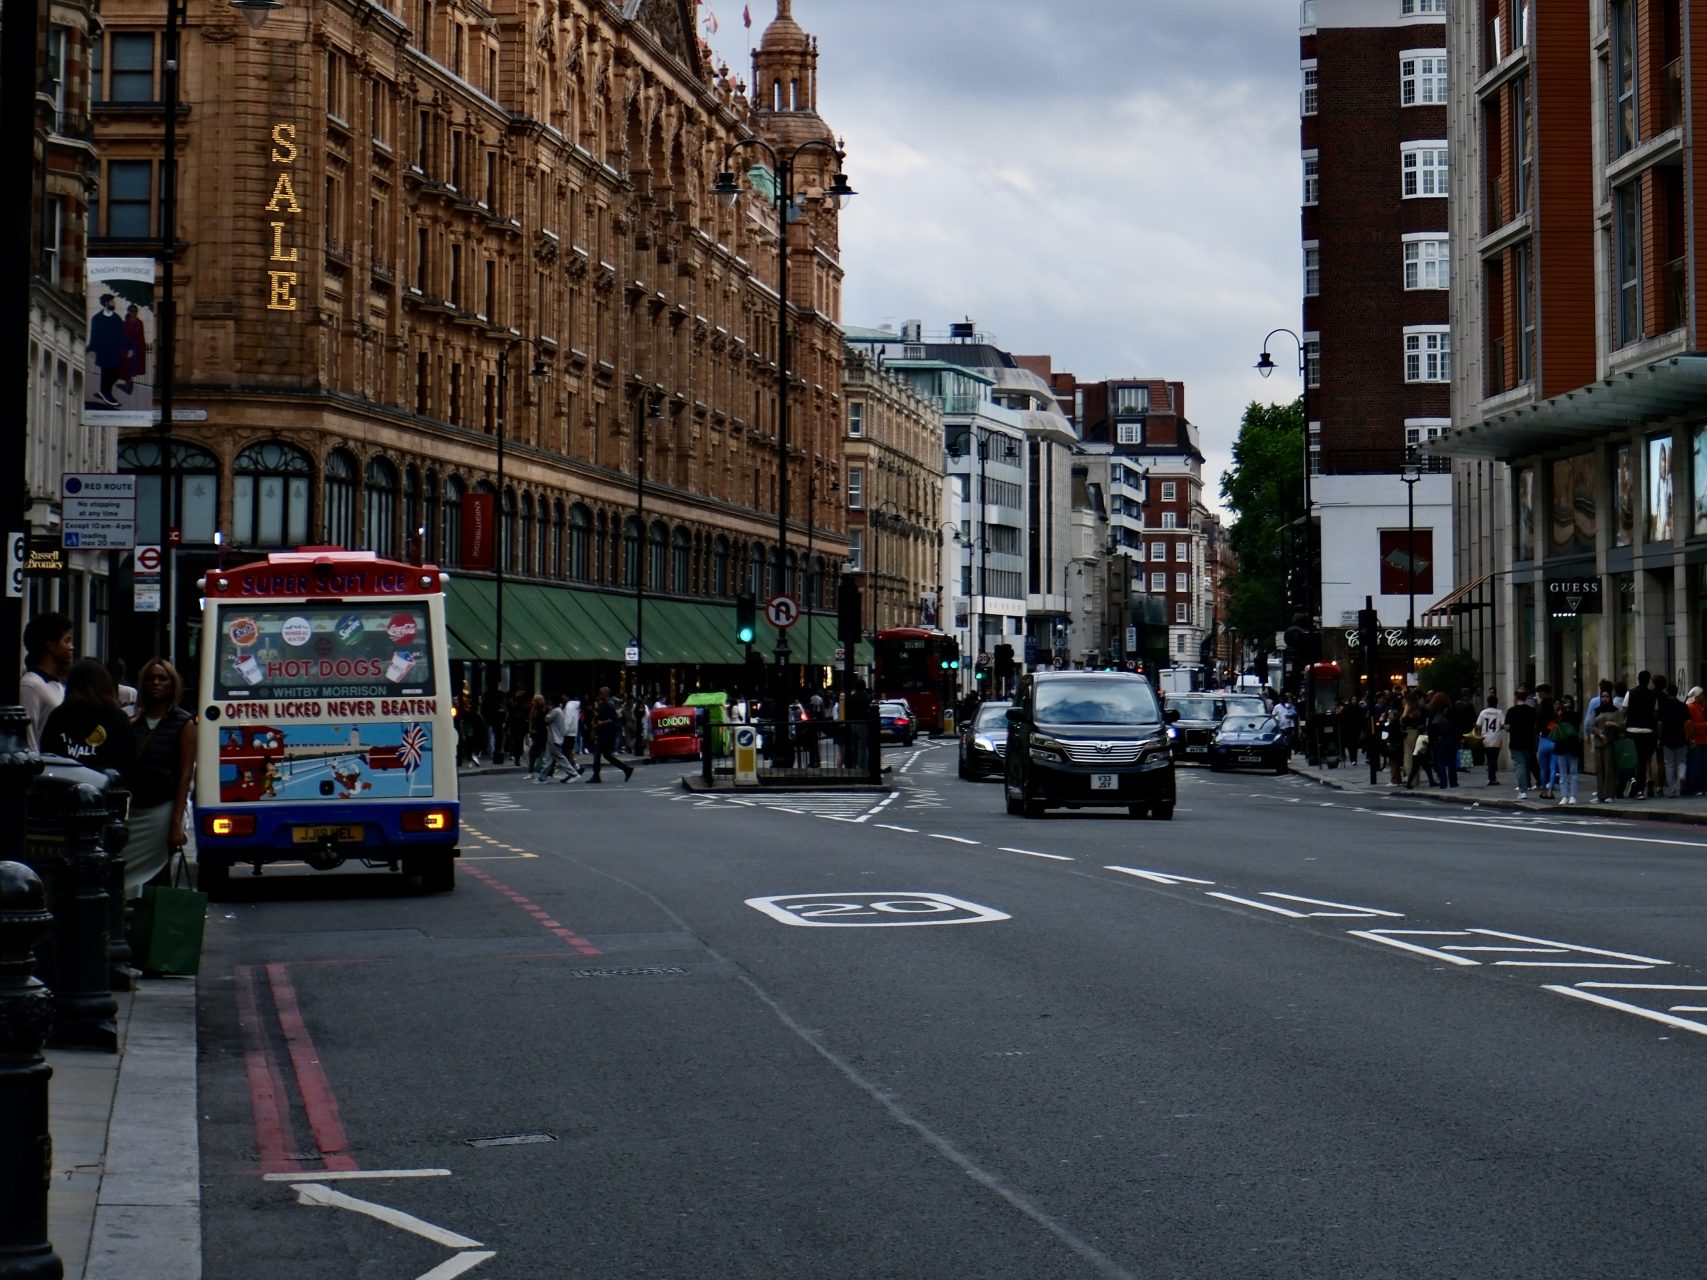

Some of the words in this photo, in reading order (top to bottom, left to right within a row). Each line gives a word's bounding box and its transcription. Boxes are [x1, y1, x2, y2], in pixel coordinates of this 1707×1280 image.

[265, 122, 302, 312] SALE
[241, 575, 307, 595] SUPER
[315, 572, 368, 593] SOFT
[373, 571, 407, 593] ICE
[1550, 582, 1598, 593] GUESS
[267, 658, 313, 679] HOT
[319, 657, 382, 678] DOGS
[273, 686, 319, 698] WHITBY
[323, 685, 387, 697] MORRISON
[225, 703, 269, 719] OFTEN
[274, 702, 321, 718] LICKED
[327, 700, 376, 717] NEVER
[381, 698, 437, 716] BEATEN
[657, 716, 690, 728] LONDON
[1485, 718, 1497, 732] 14
[785, 900, 955, 917] 20
